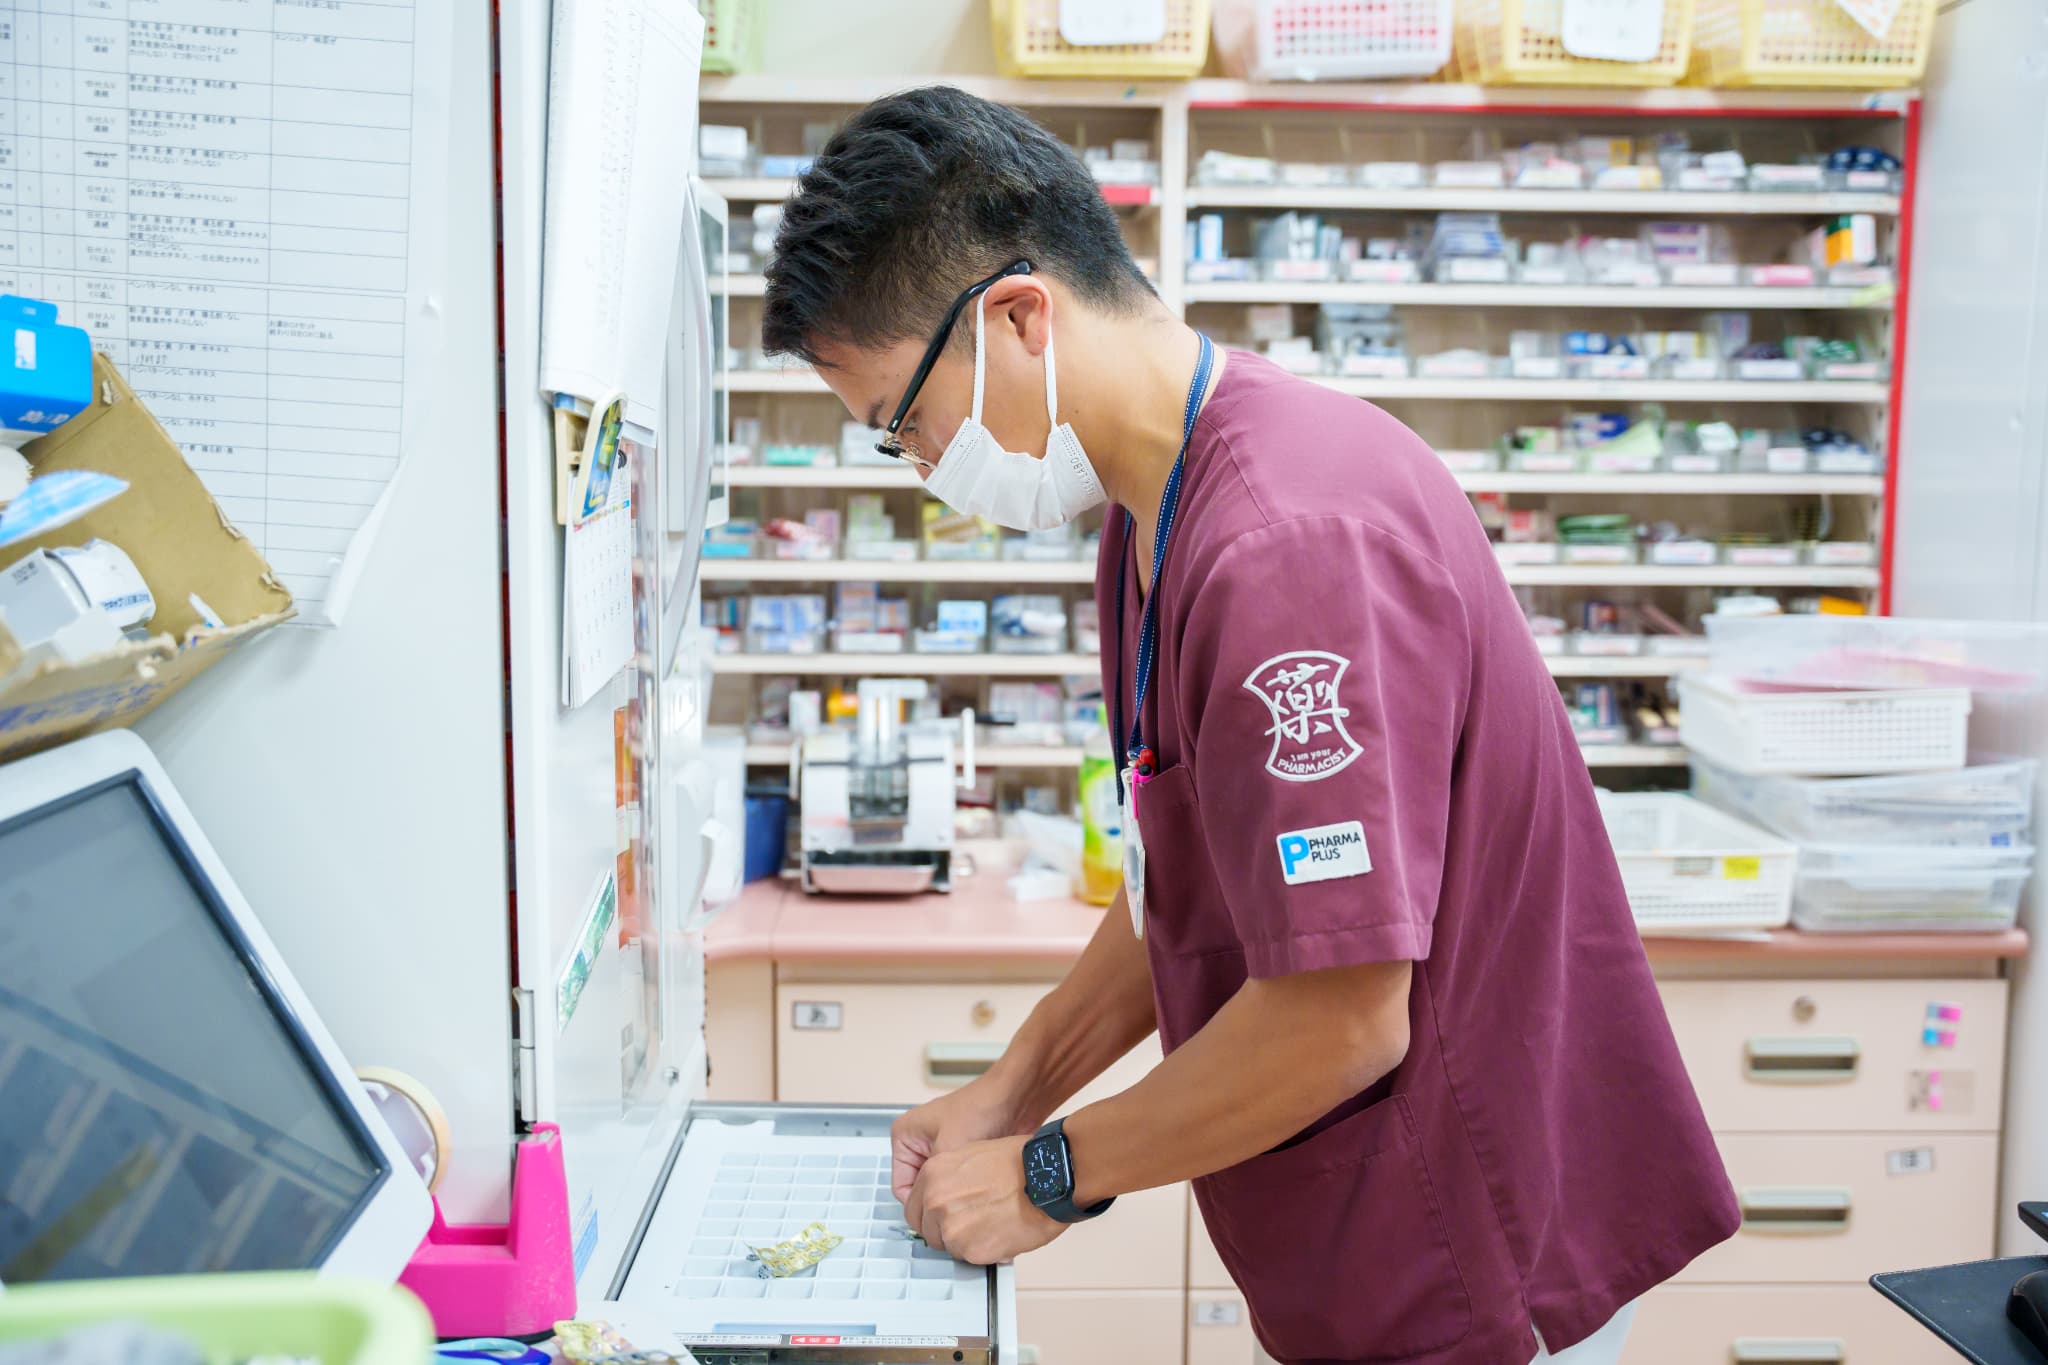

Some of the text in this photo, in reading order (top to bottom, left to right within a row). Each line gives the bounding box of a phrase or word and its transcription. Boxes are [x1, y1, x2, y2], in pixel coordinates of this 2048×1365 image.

[1277, 747, 1347, 774] PHARMACIST
[1309, 748, 1331, 761] your
[1308, 831, 1361, 850] PHARMA
[1311, 847, 1342, 863] PLUS
